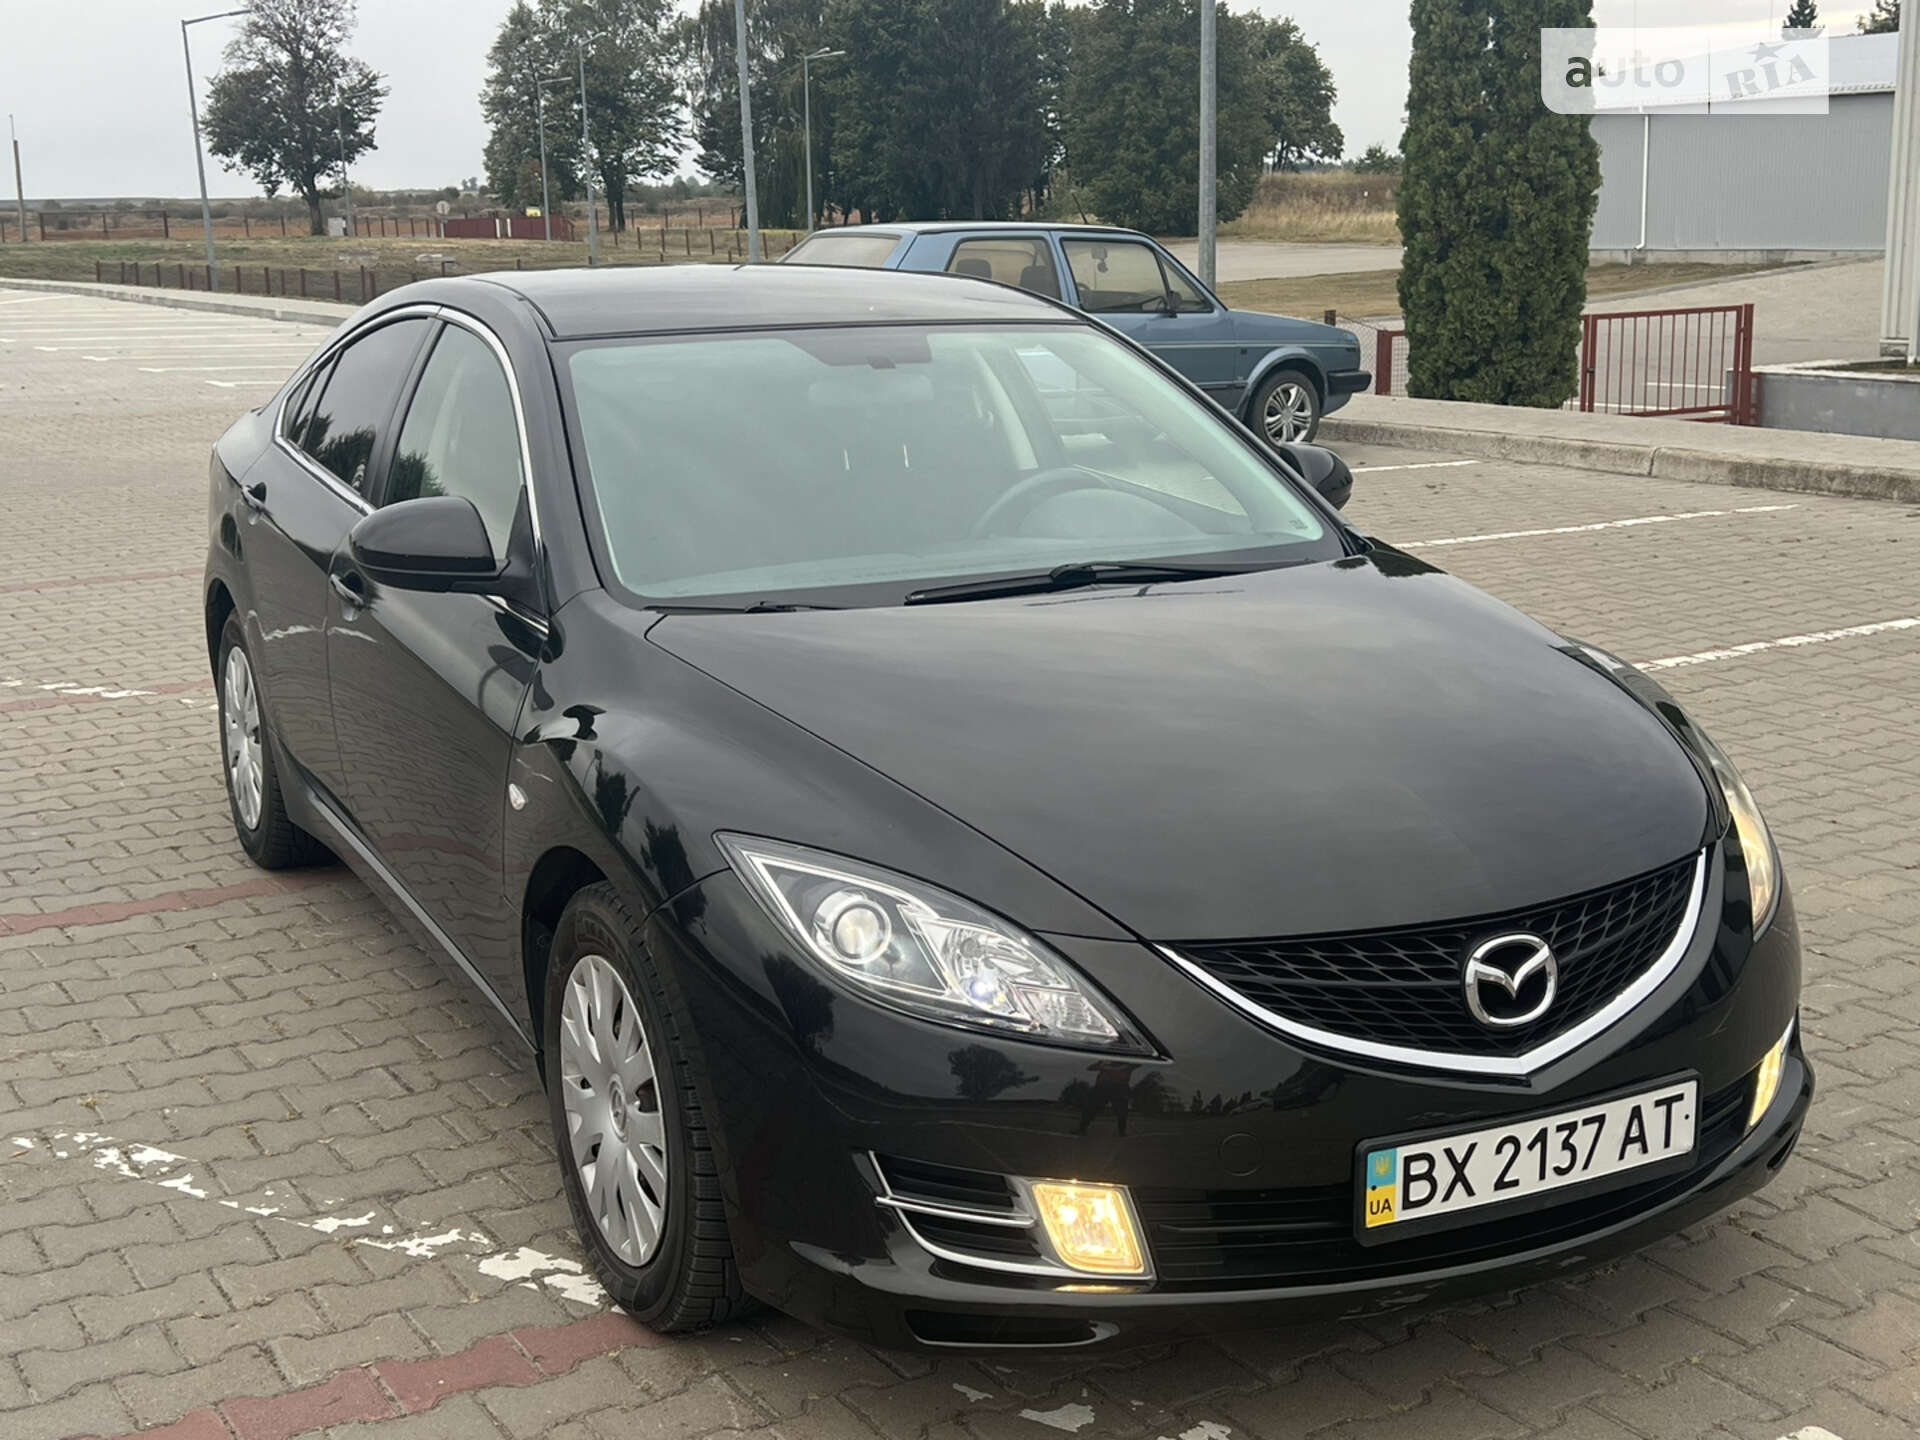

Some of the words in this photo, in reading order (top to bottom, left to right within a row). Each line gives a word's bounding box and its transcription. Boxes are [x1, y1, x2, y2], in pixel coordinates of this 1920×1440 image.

[1402, 1142, 1478, 1211] BX
[1493, 1113, 1607, 1192] 2137
[1617, 1093, 1685, 1161] AT
[1369, 1198, 1393, 1216] UA
